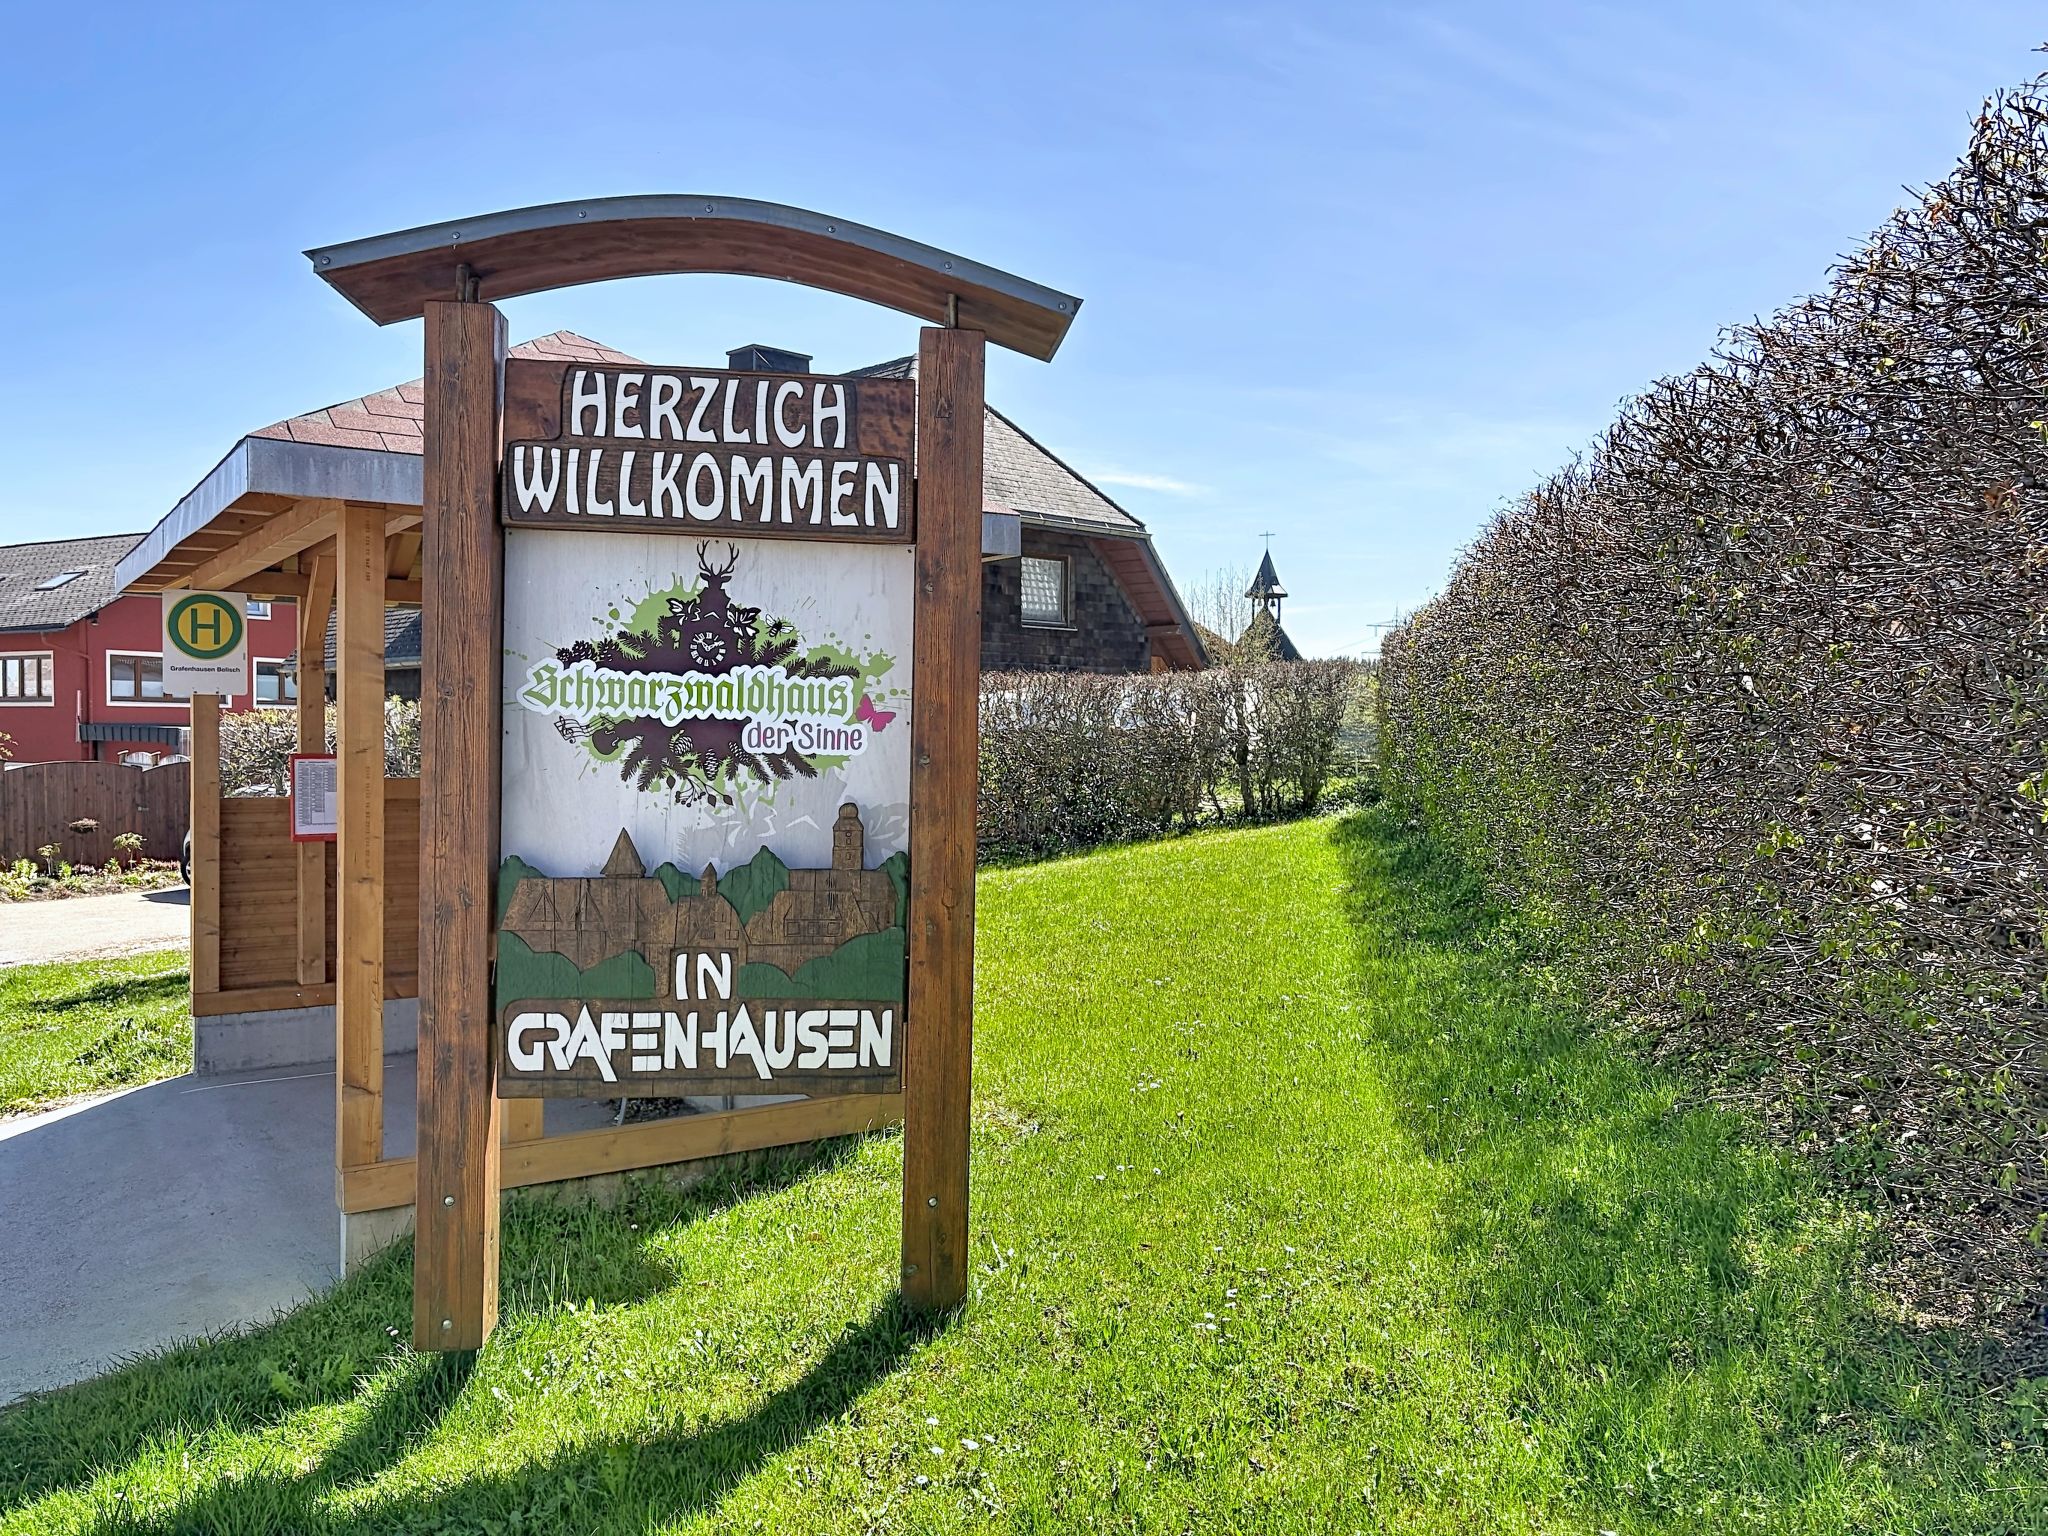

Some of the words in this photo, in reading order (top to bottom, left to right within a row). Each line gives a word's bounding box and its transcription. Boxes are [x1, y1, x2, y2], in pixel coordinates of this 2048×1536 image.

[571, 370, 846, 449] HERZLICH
[513, 446, 899, 529] WILLKOMMEN
[190, 608, 221, 645] H
[170, 665, 215, 673] Grafenhausen
[522, 663, 848, 722] Schwarzwaldhaus
[747, 721, 790, 749] der
[798, 723, 863, 751] Sinne
[675, 952, 731, 1000] IN
[507, 1003, 893, 1082] GRAFENHAUSEN
